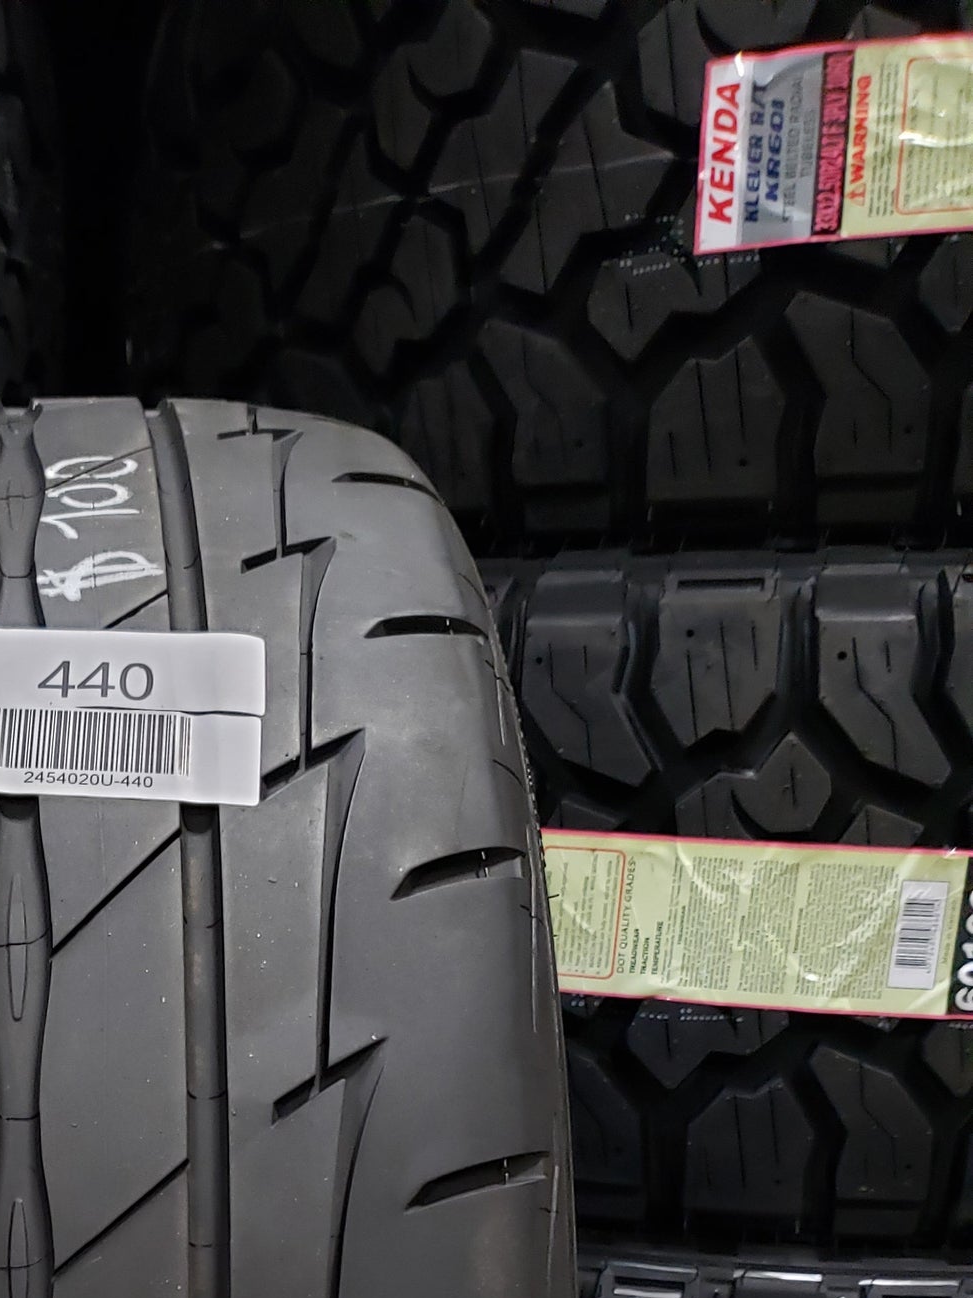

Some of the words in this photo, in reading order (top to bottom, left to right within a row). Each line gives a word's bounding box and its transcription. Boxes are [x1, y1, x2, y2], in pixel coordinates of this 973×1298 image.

[749, 85, 767, 128] R/T
[765, 98, 786, 202] KR601
[849, 75, 872, 184] WARNING
[708, 82, 742, 224] KENDA
[745, 134, 764, 223] KLEVER
[37, 660, 154, 700] 440
[23, 770, 154, 789] 2454020U-440
[619, 905, 632, 950] QUALITY
[651, 921, 664, 975] TEMPERATURE
[616, 953, 625, 974] DOT
[640, 937, 650, 975] TRACTION
